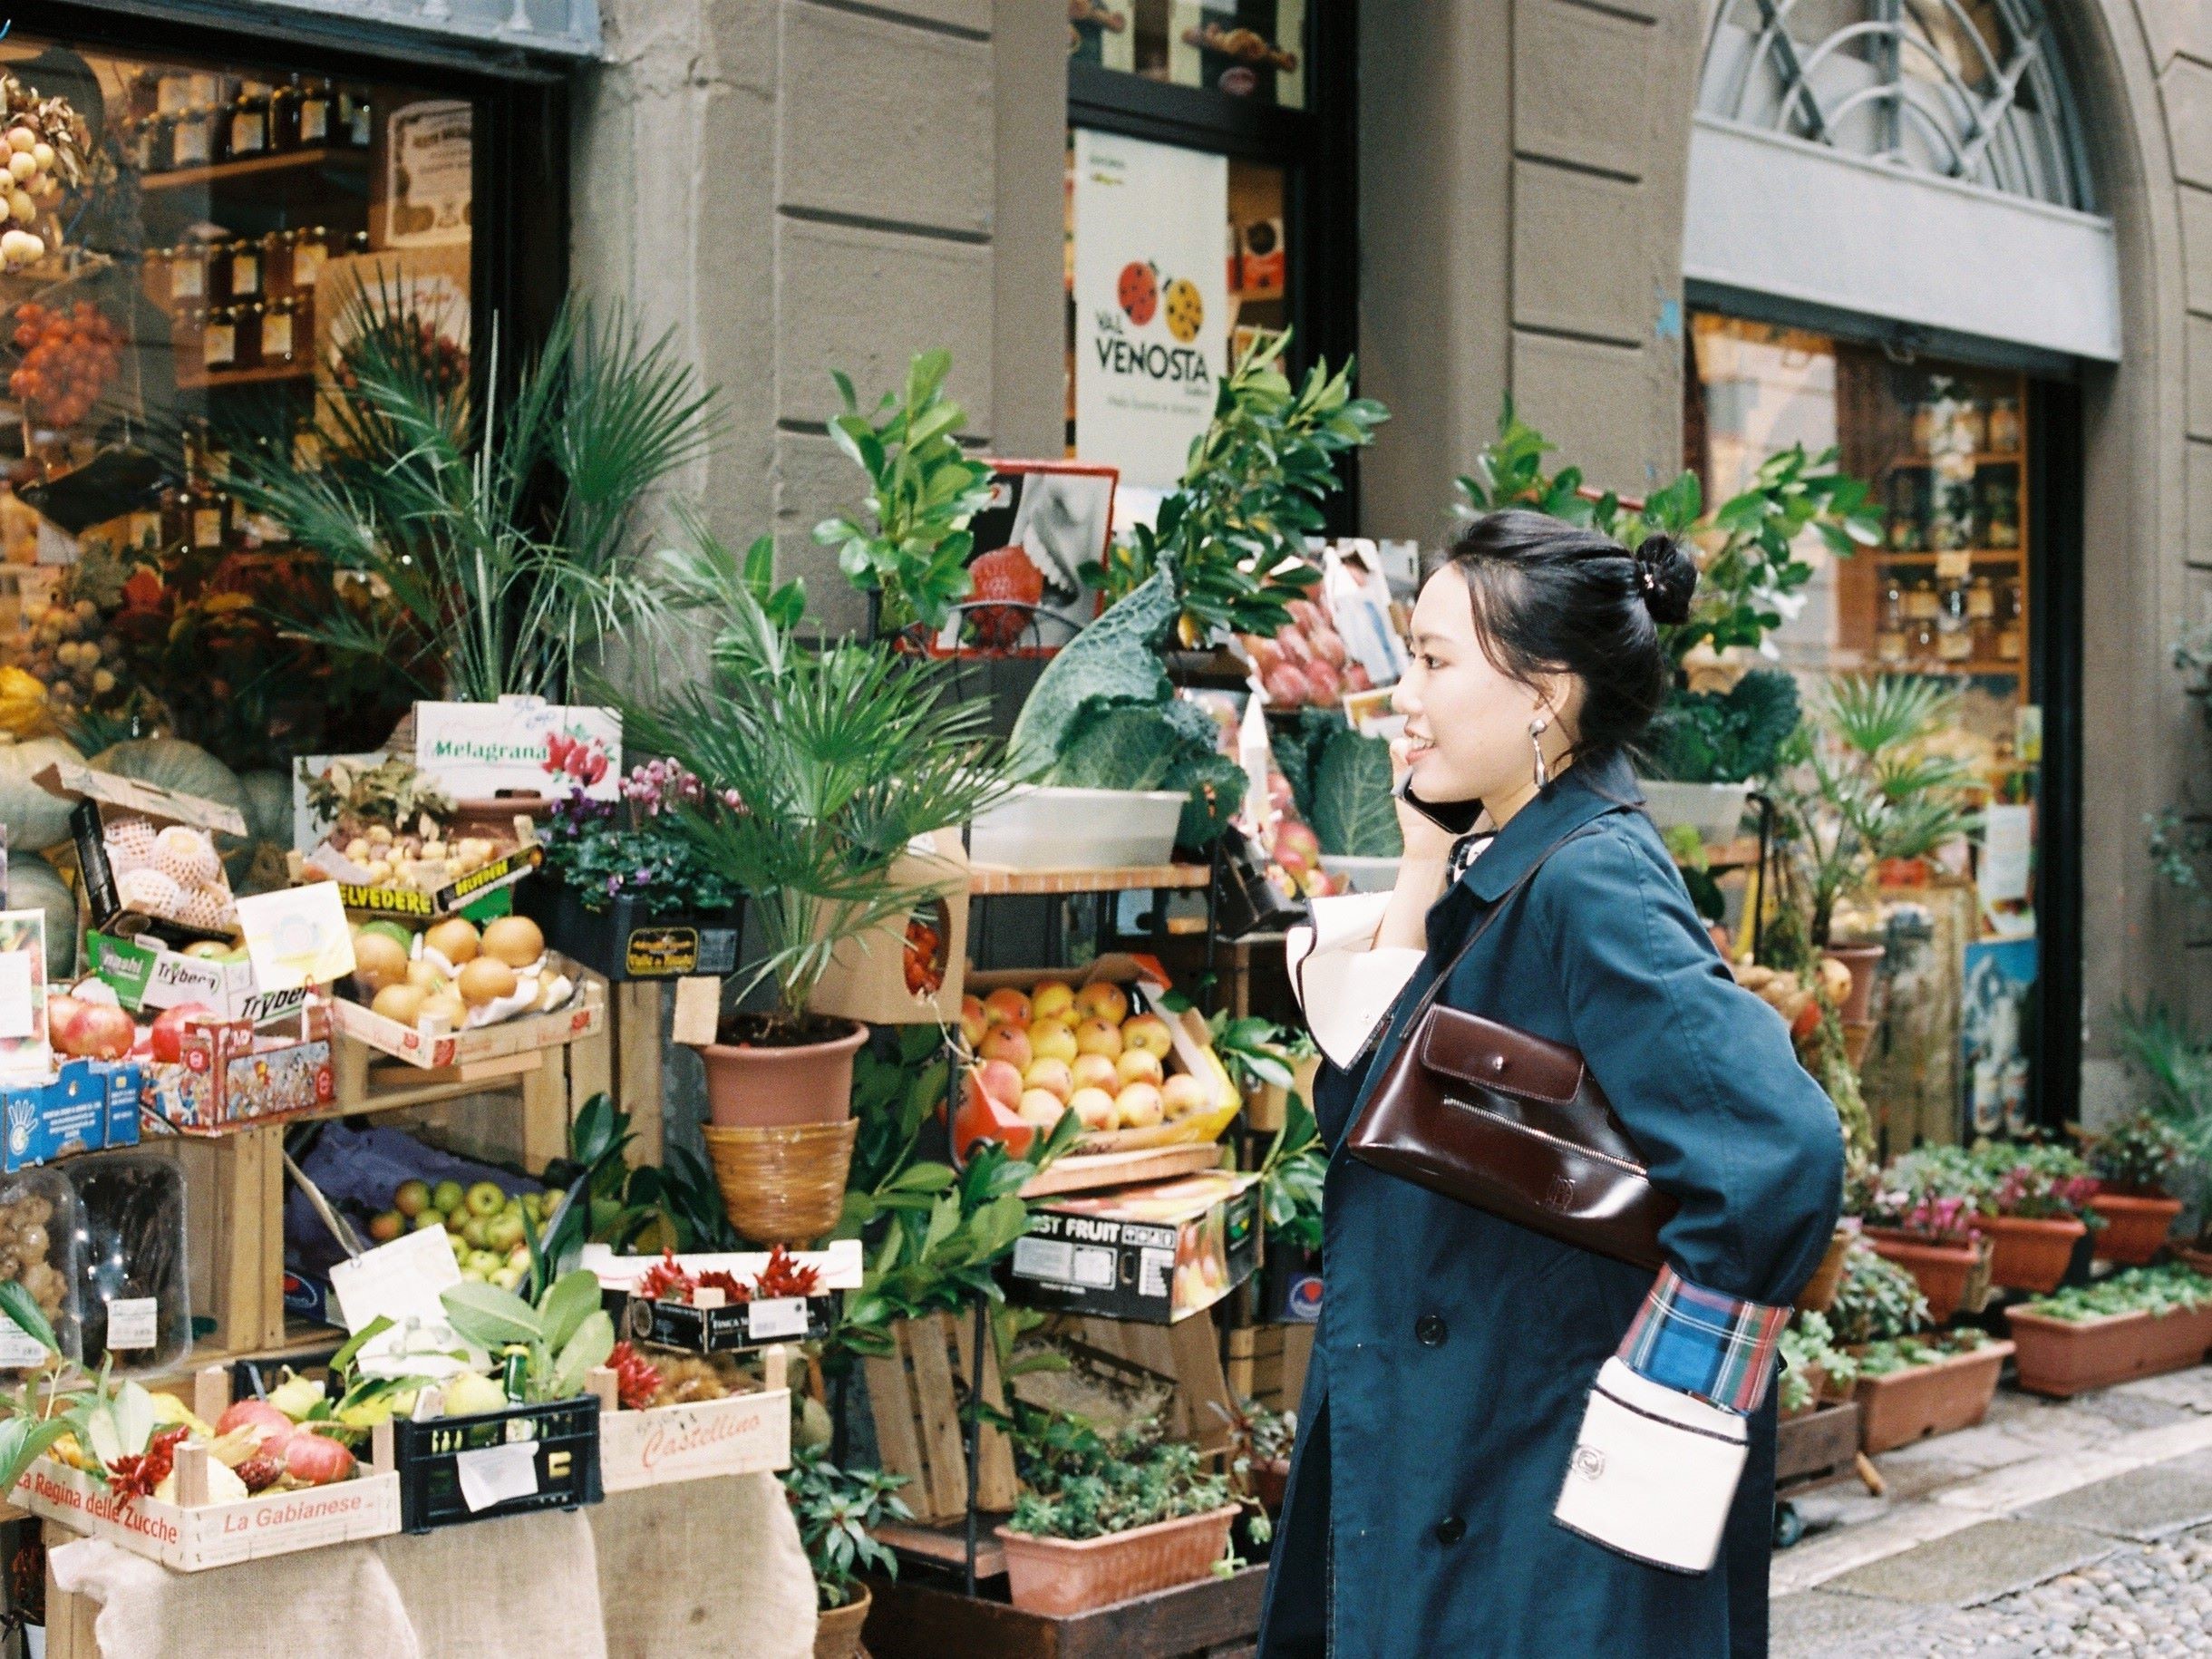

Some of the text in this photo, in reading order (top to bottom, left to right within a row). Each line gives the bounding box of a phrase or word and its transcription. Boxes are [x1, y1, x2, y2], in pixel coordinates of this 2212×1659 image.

[1095, 337, 1209, 383] VENOSTA
[435, 740, 548, 762] Melagrana
[338, 883, 433, 914] ELVEDERE
[1032, 1214, 1121, 1243] EST FRUIT
[34, 1472, 82, 1509] Regina
[85, 1491, 121, 1524] delle
[124, 1506, 178, 1544] Zucche
[224, 1496, 362, 1533] La Gabianese
